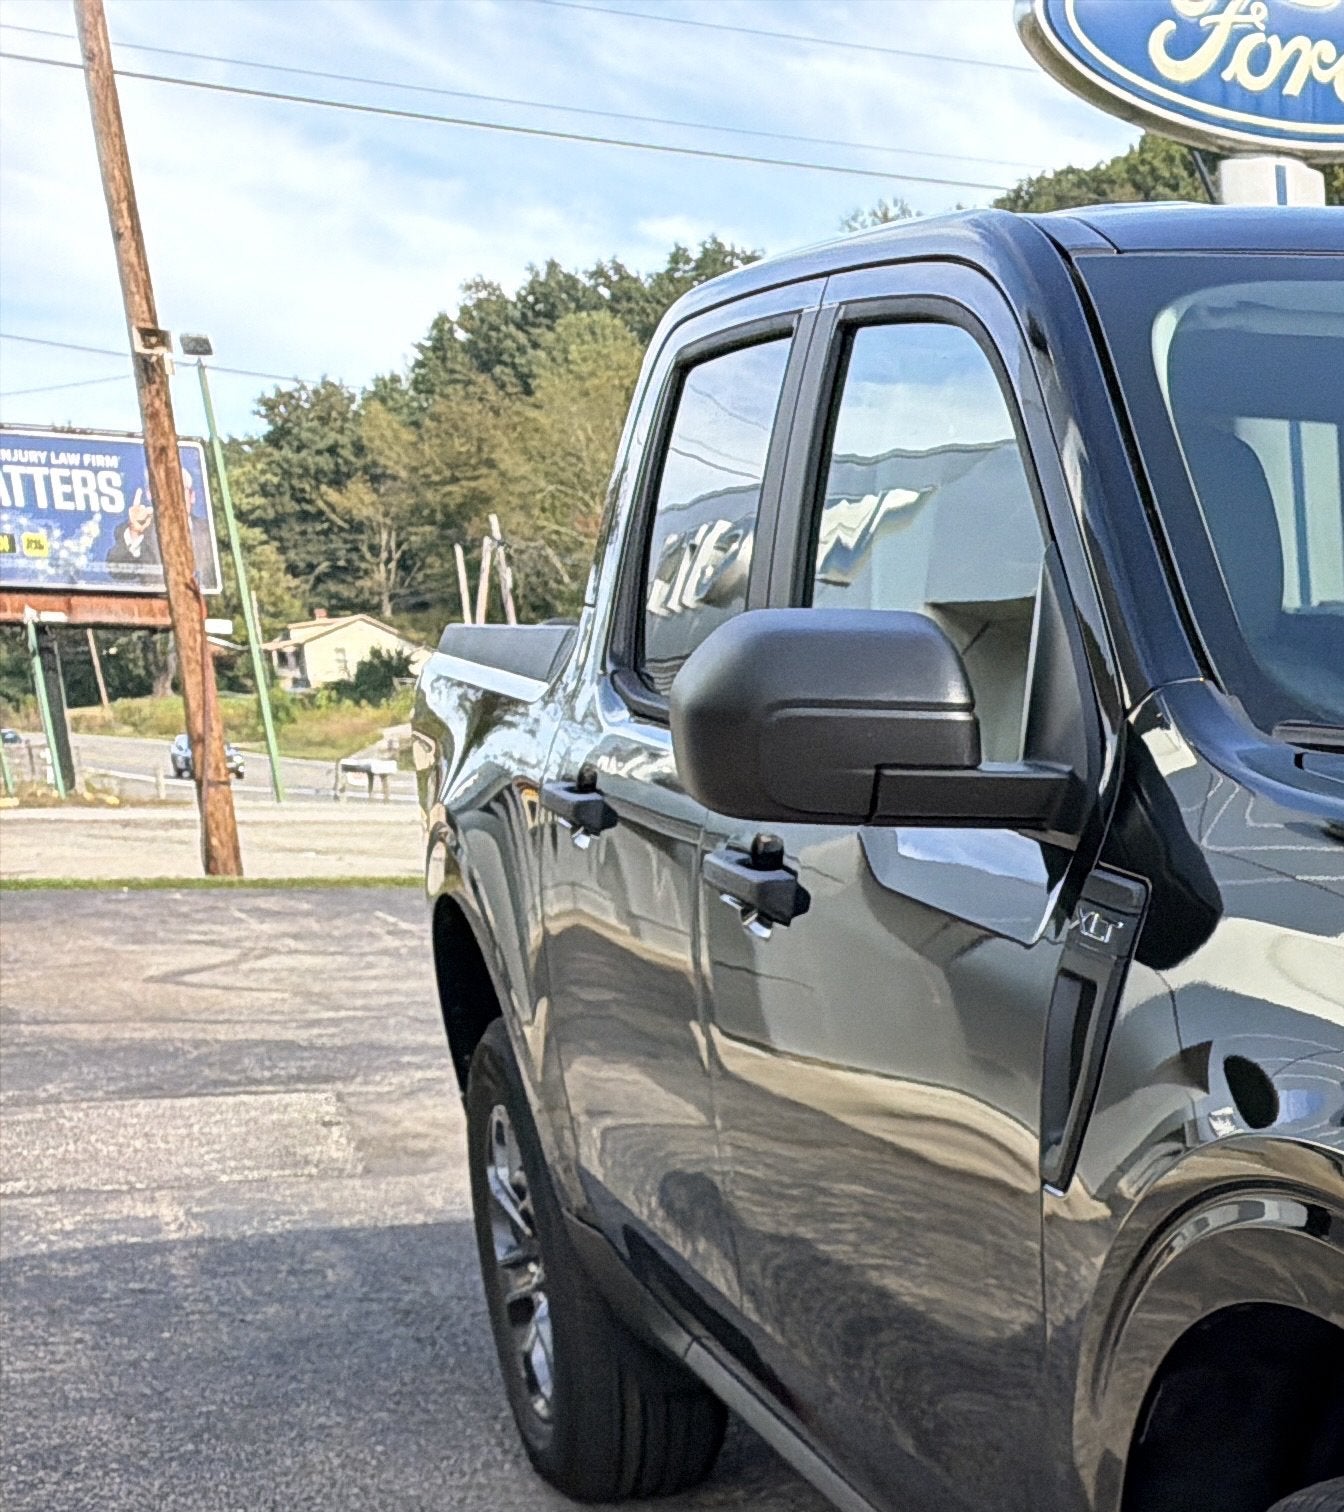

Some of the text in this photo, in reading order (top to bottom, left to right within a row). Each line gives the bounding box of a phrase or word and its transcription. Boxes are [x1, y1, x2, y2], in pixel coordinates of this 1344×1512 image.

[50, 450, 80, 466] LAW
[83, 453, 118, 469] FIRM
[1068, 907, 1124, 944] XLT
